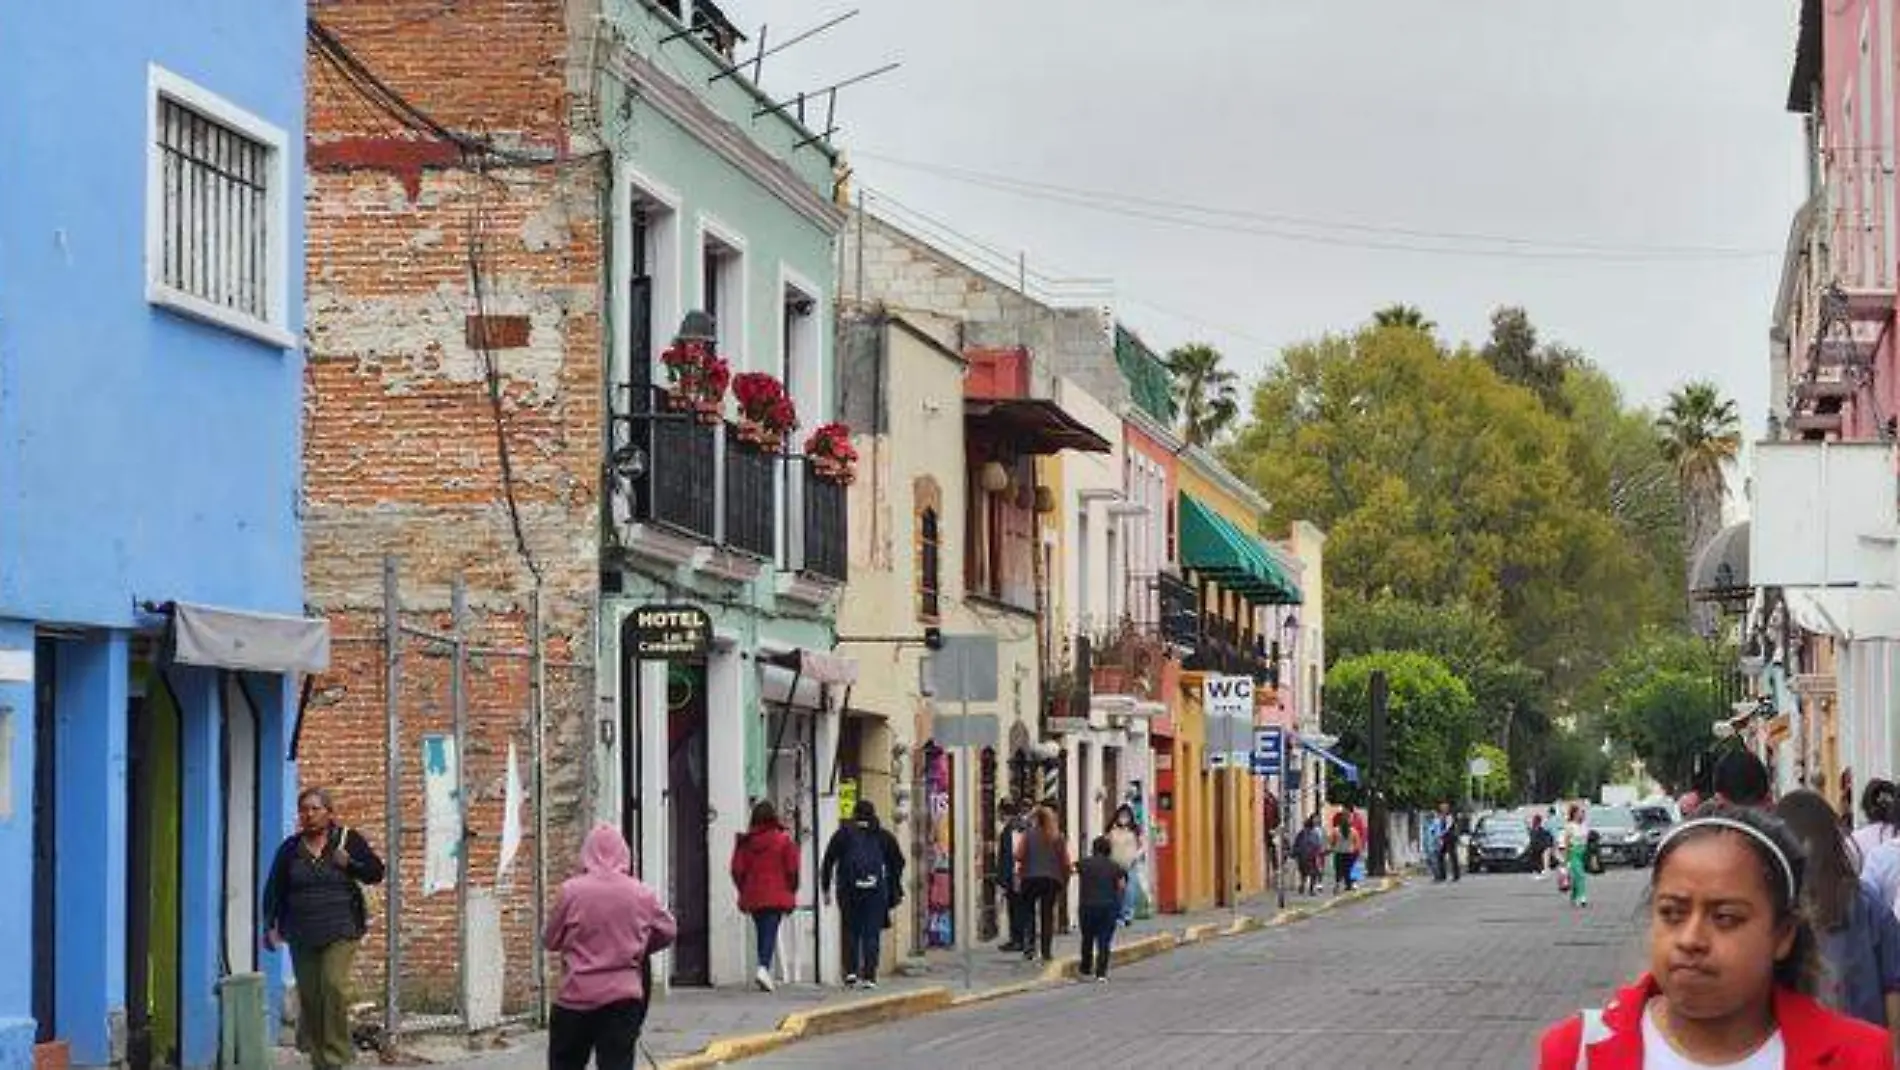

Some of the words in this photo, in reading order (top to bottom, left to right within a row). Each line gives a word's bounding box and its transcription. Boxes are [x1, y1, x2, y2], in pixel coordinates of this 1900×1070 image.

[638, 611, 703, 628] HOTEL
[1208, 679, 1250, 698] WC
[1254, 731, 1280, 759] E
